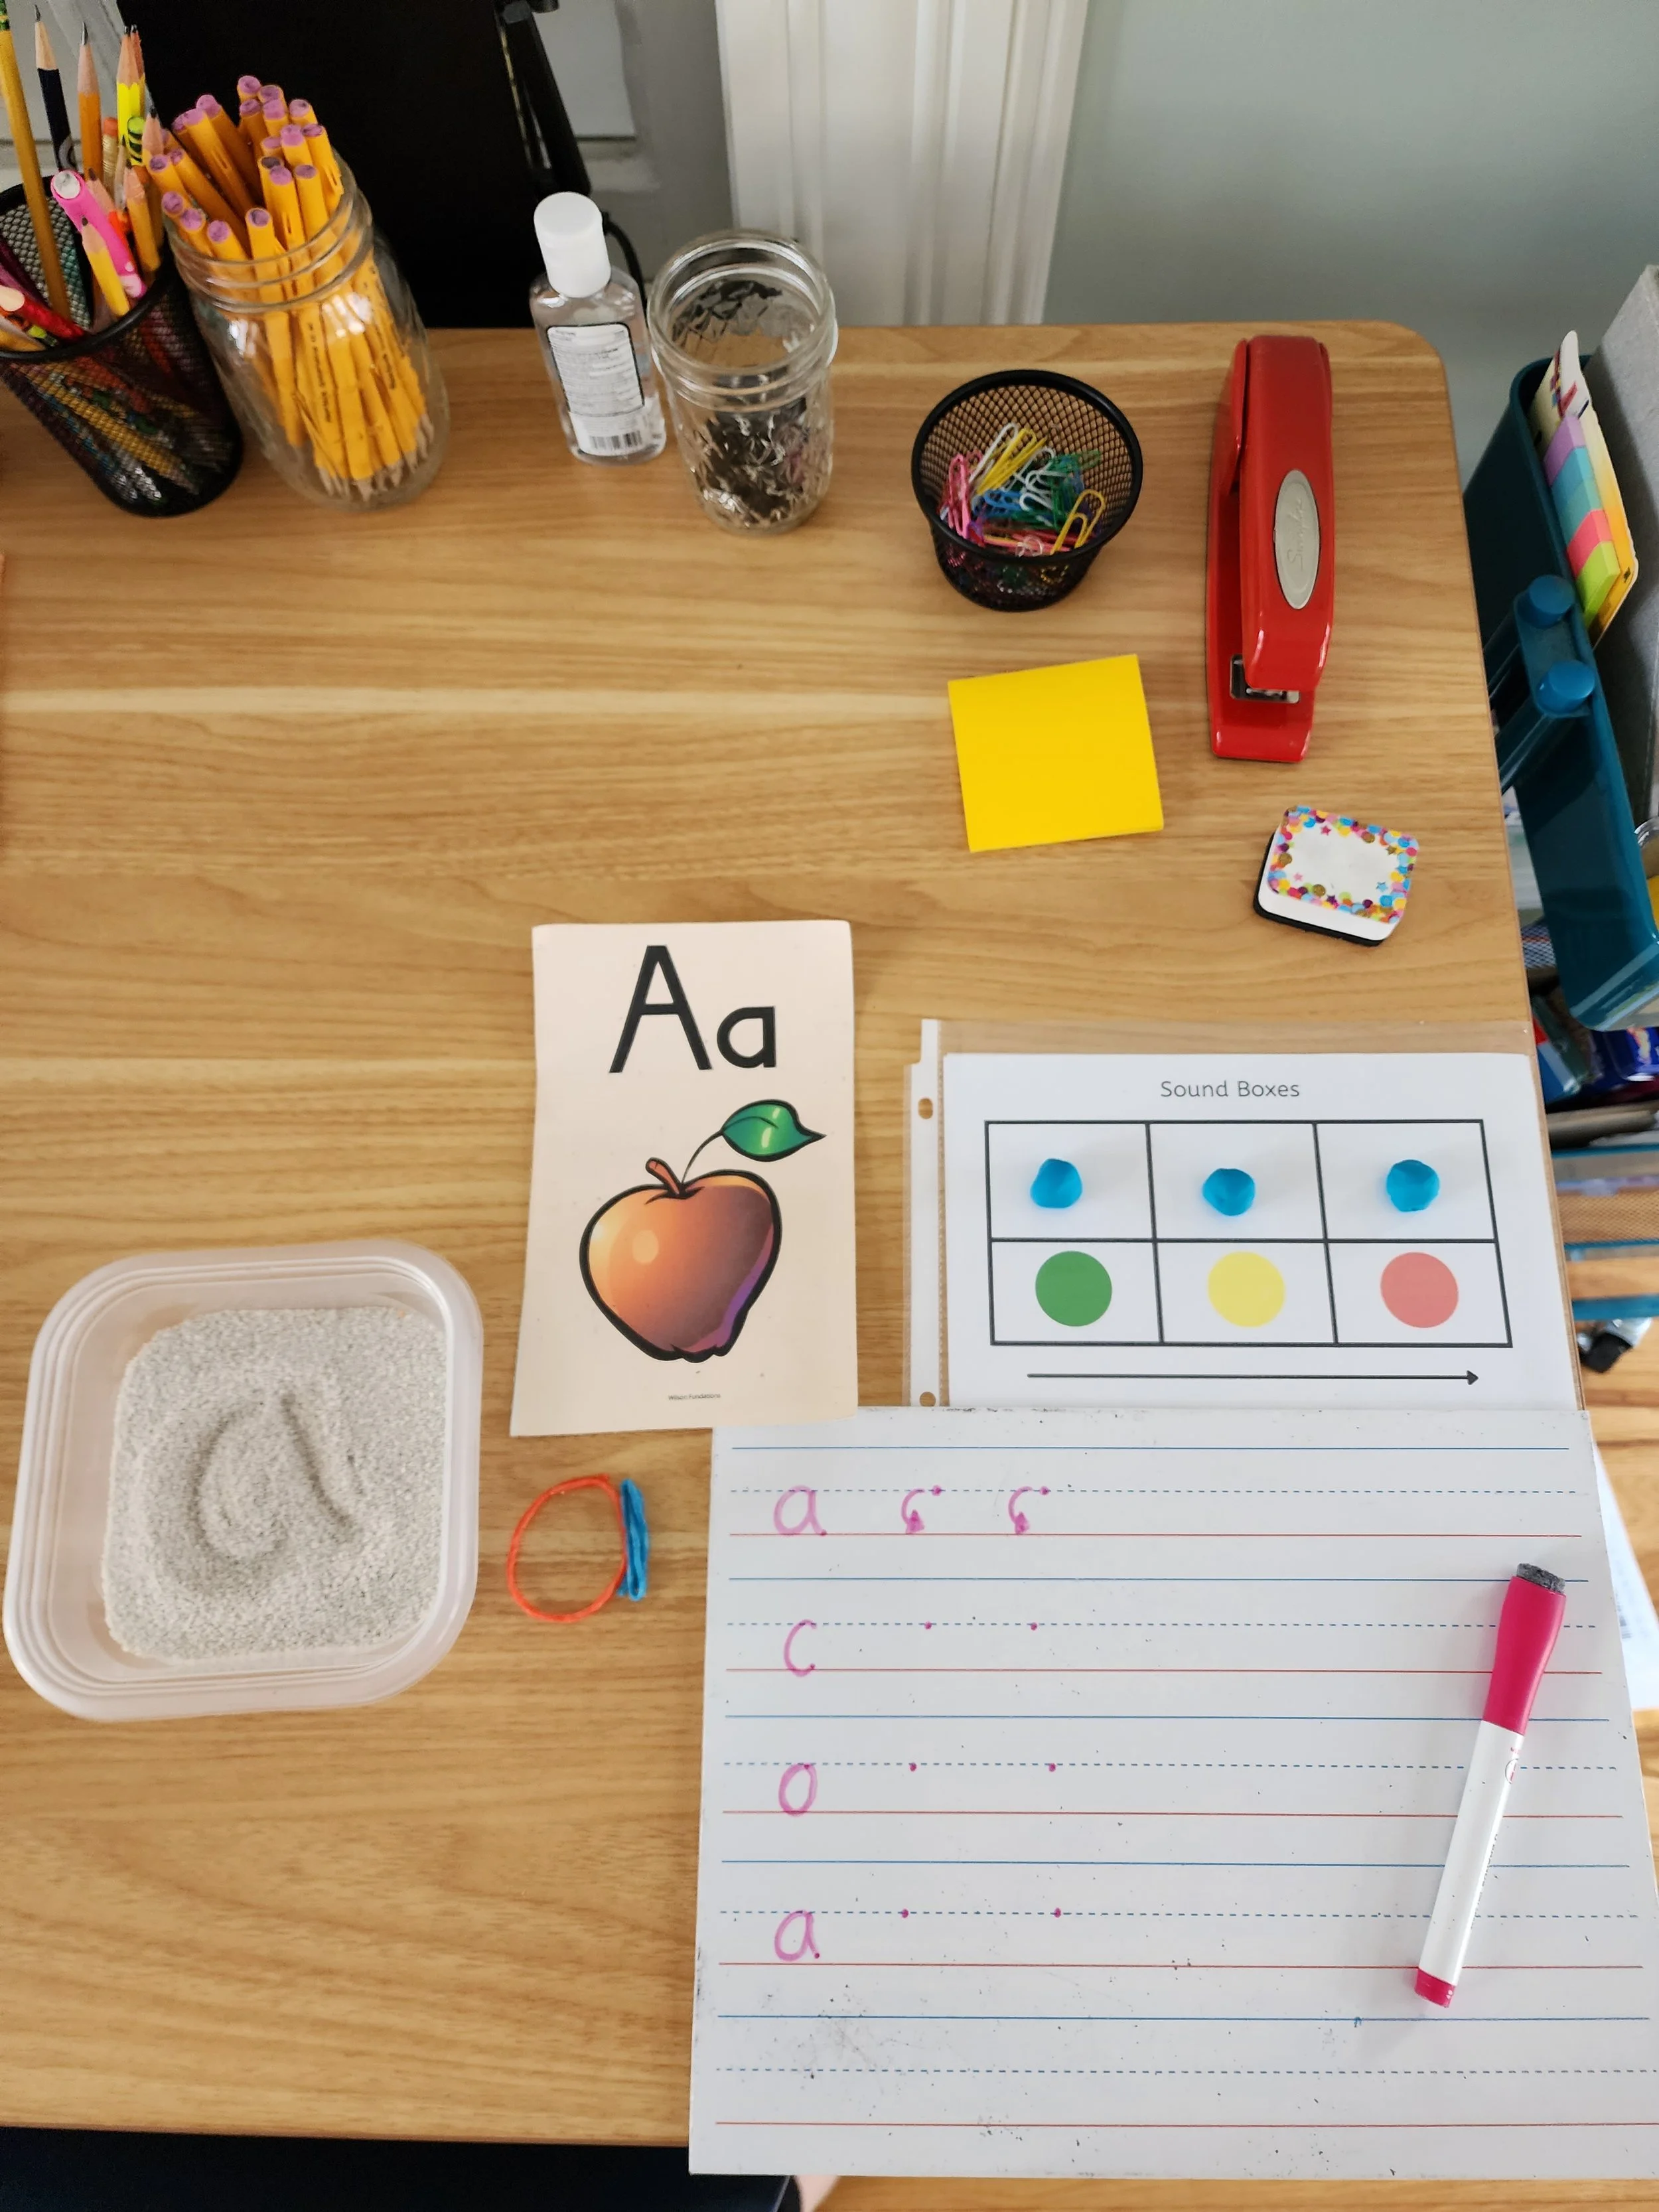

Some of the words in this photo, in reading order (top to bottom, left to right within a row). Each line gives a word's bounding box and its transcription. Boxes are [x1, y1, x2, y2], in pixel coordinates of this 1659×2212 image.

[610, 946, 776, 1072] Aa
[1161, 1080, 1228, 1097] Sound
[1238, 1081, 1299, 1096] Boxes
[774, 1487, 826, 1536] a
[774, 1909, 820, 1962] a
